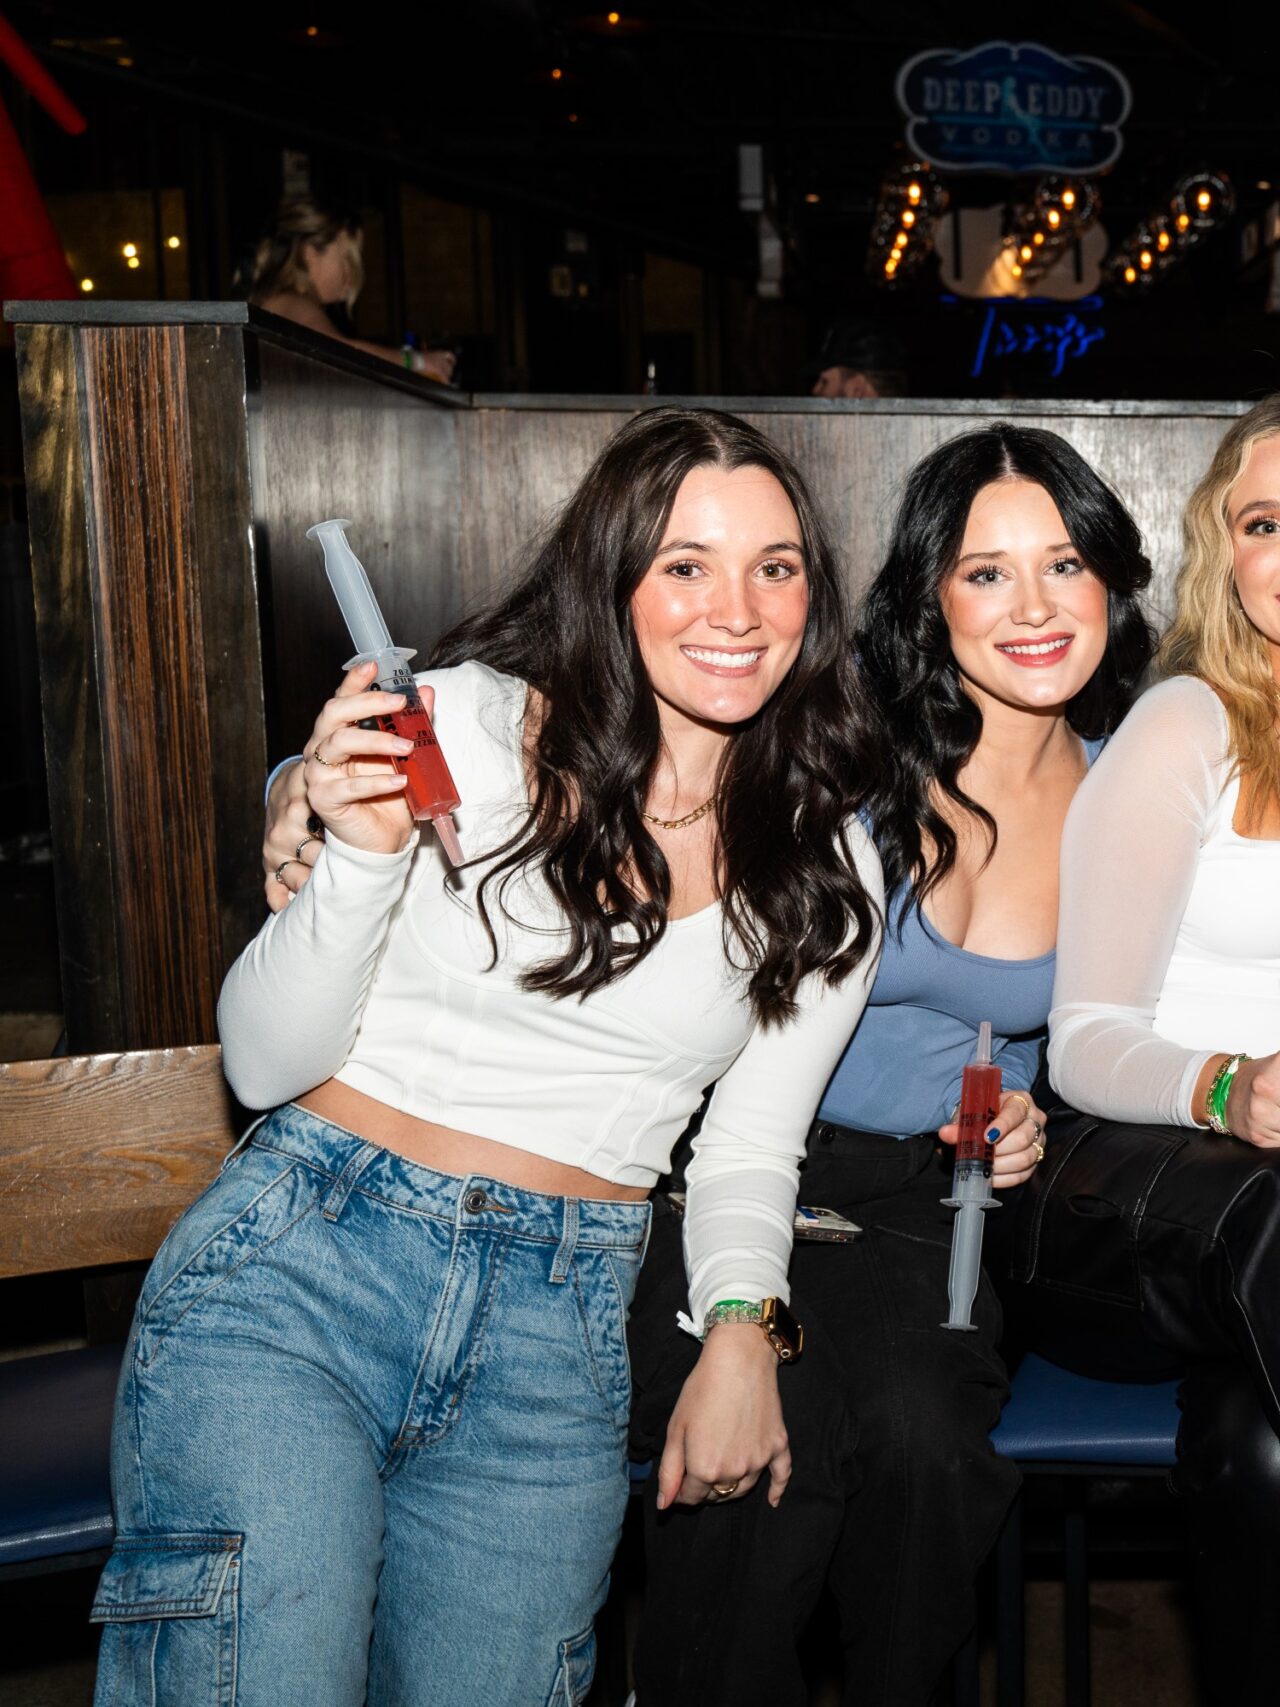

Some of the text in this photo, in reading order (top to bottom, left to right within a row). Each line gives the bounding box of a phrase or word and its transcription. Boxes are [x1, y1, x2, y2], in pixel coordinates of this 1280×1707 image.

[922, 76, 1106, 118] DEEP EDDY
[941, 125, 1093, 148] VODKA
[392, 676, 414, 686] WILD
